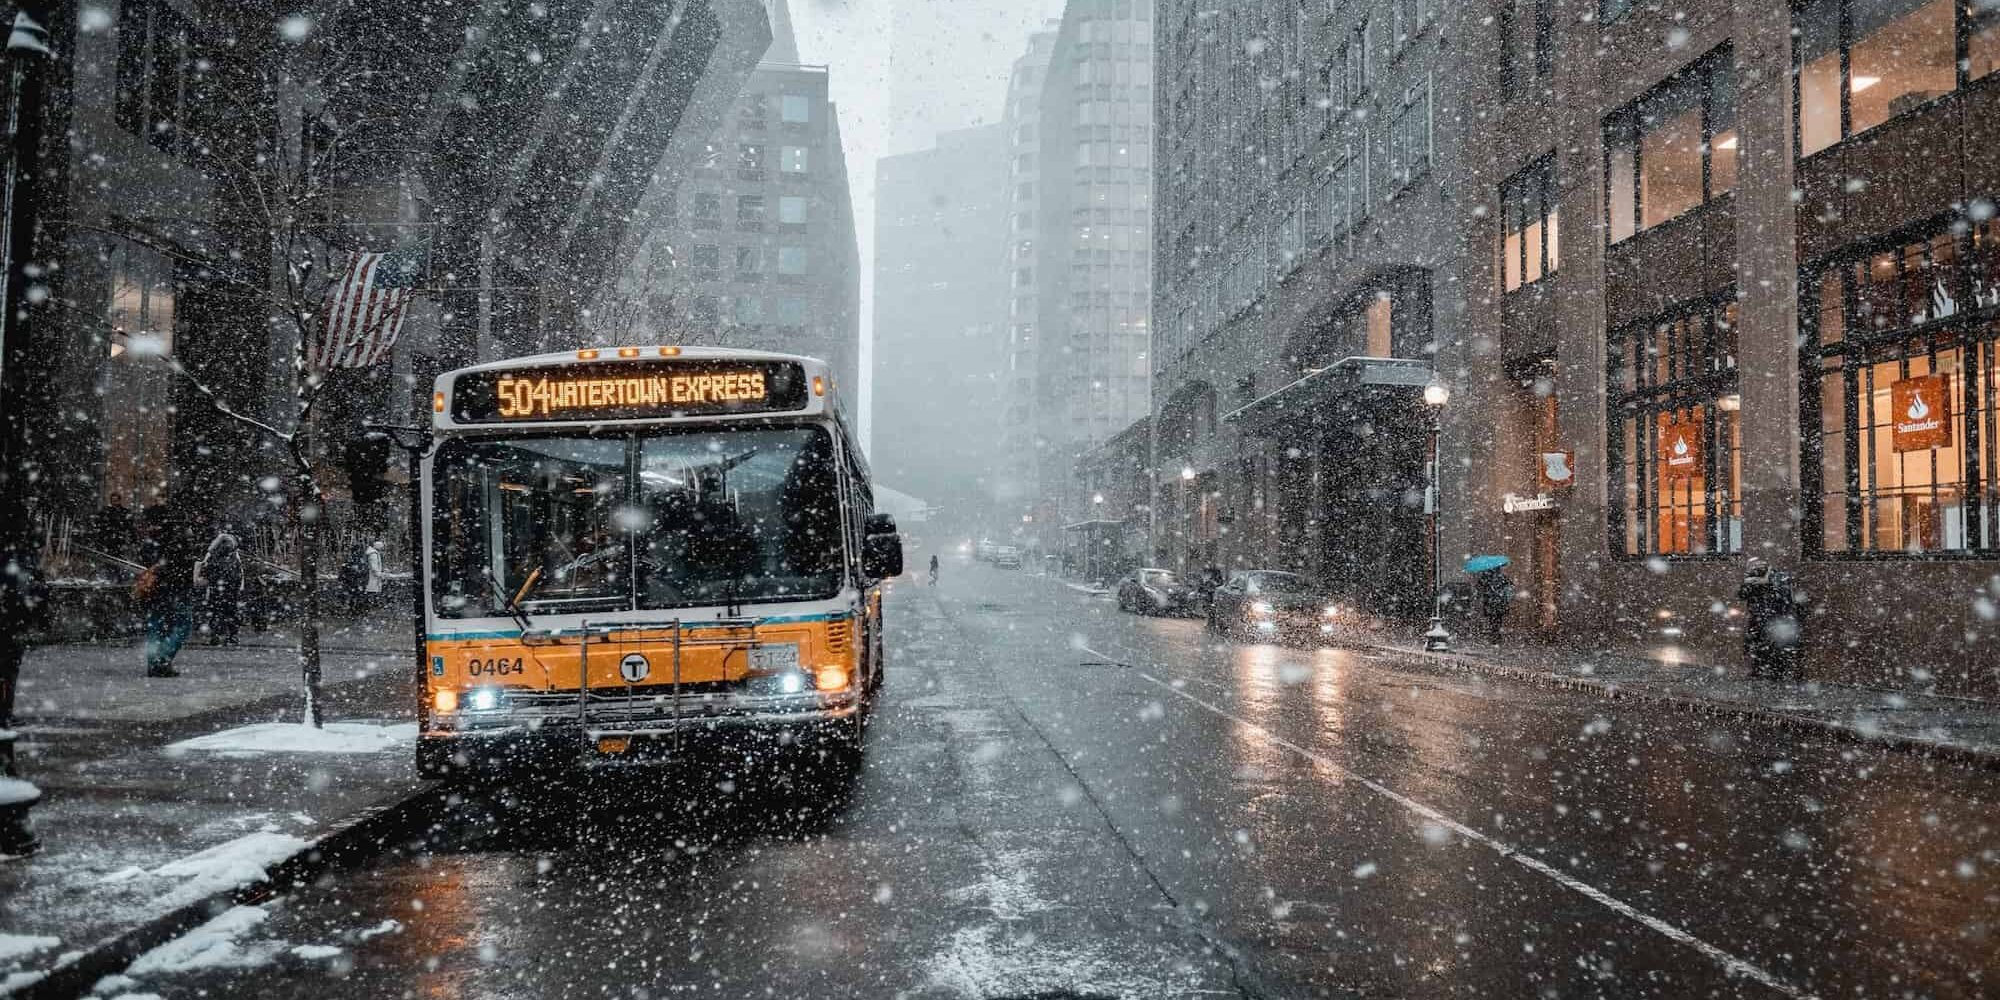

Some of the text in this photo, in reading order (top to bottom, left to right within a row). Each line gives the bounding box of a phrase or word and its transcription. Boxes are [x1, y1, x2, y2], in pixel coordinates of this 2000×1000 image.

[498, 372, 765, 416] 504 WATERTOWN EXPRESS
[1898, 418, 1938, 433] Santander
[469, 657, 524, 676] 0464
[625, 660, 644, 678] T
